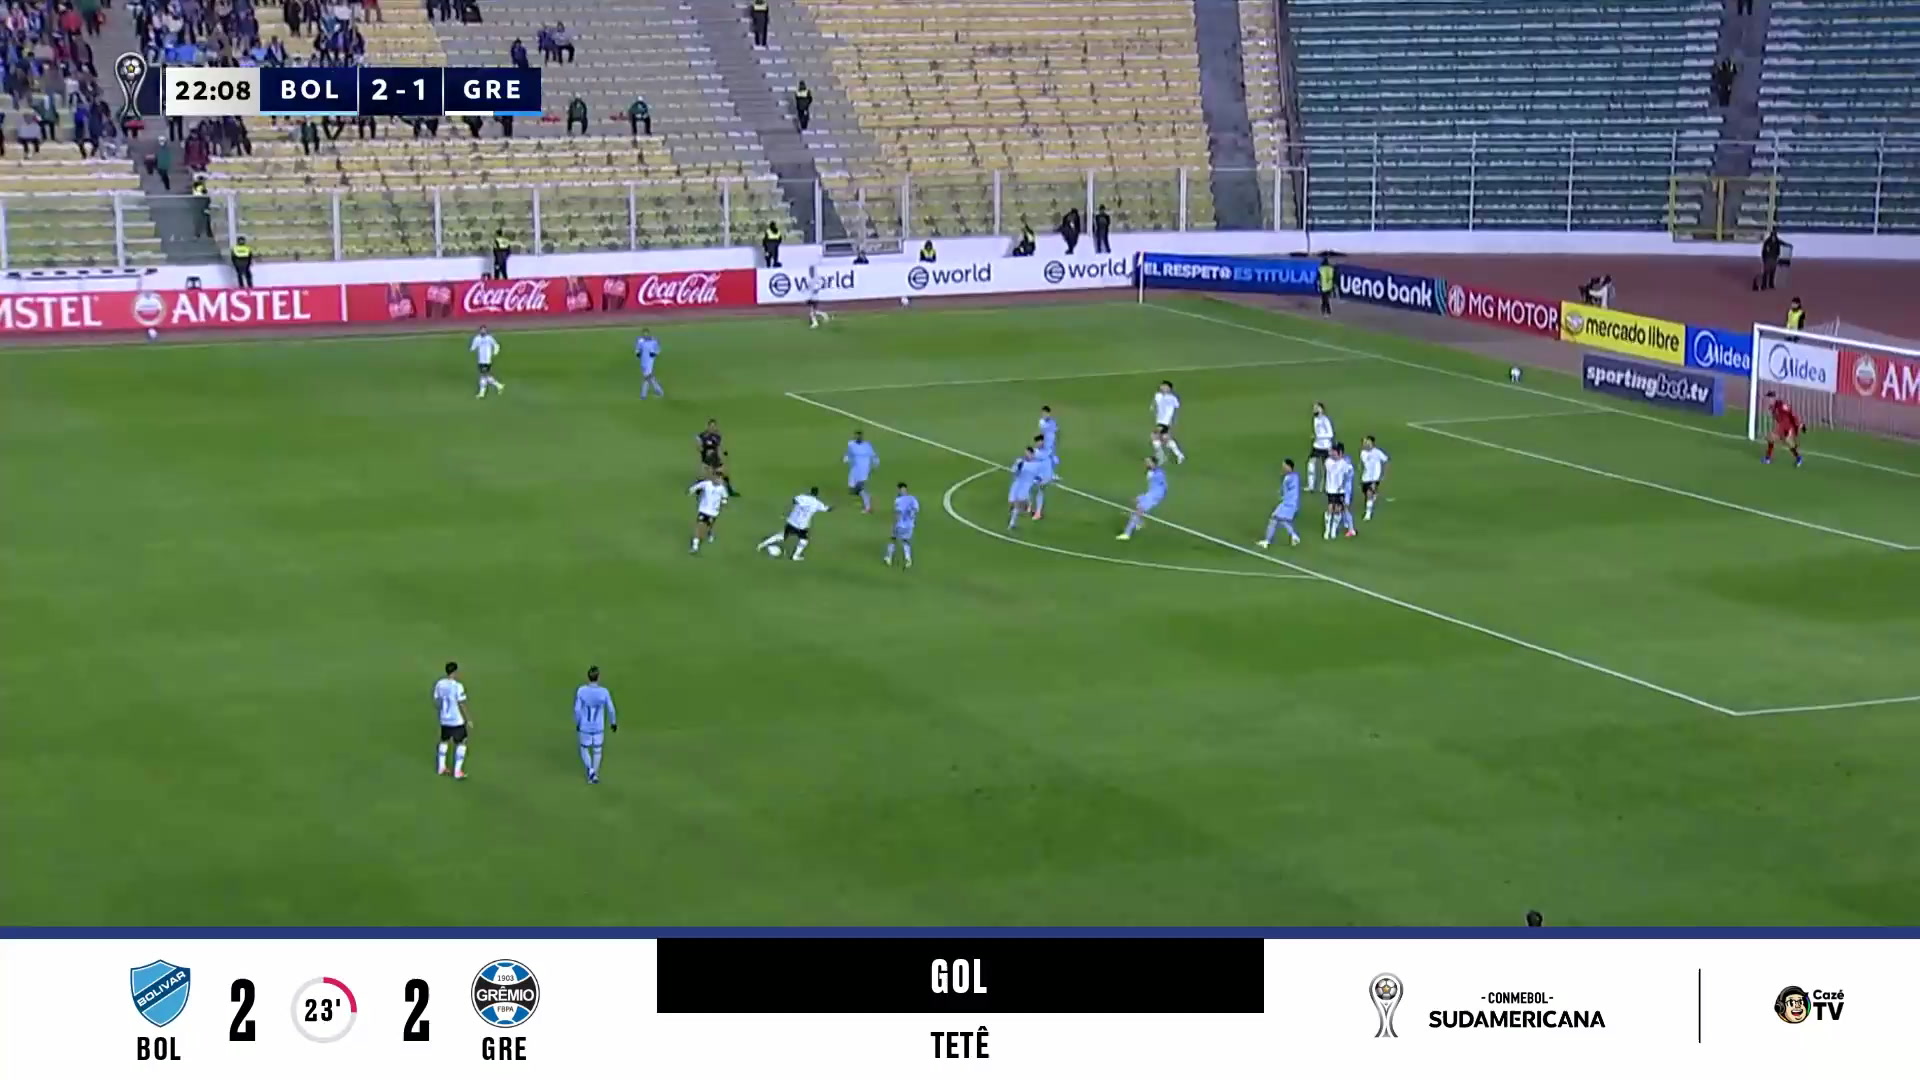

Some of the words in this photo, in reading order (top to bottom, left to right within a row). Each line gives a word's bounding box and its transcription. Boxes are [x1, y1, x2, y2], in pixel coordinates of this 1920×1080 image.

[932, 262, 992, 285] world
[1068, 257, 1126, 279] world
[1144, 262, 1161, 276] EL
[1234, 267, 1252, 281] ES
[171, 289, 311, 324] AMSTEL
[1340, 275, 1385, 299] ueno
[1387, 280, 1432, 307] bank
[1468, 290, 1494, 318] MG
[1586, 317, 1646, 345] mercado
[1648, 325, 1680, 351] libre
[1697, 335, 1750, 369] Midea
[1772, 348, 1826, 383] Midea
[1587, 366, 1709, 402] sportingbet.tv
[587, 704, 600, 722] 17
